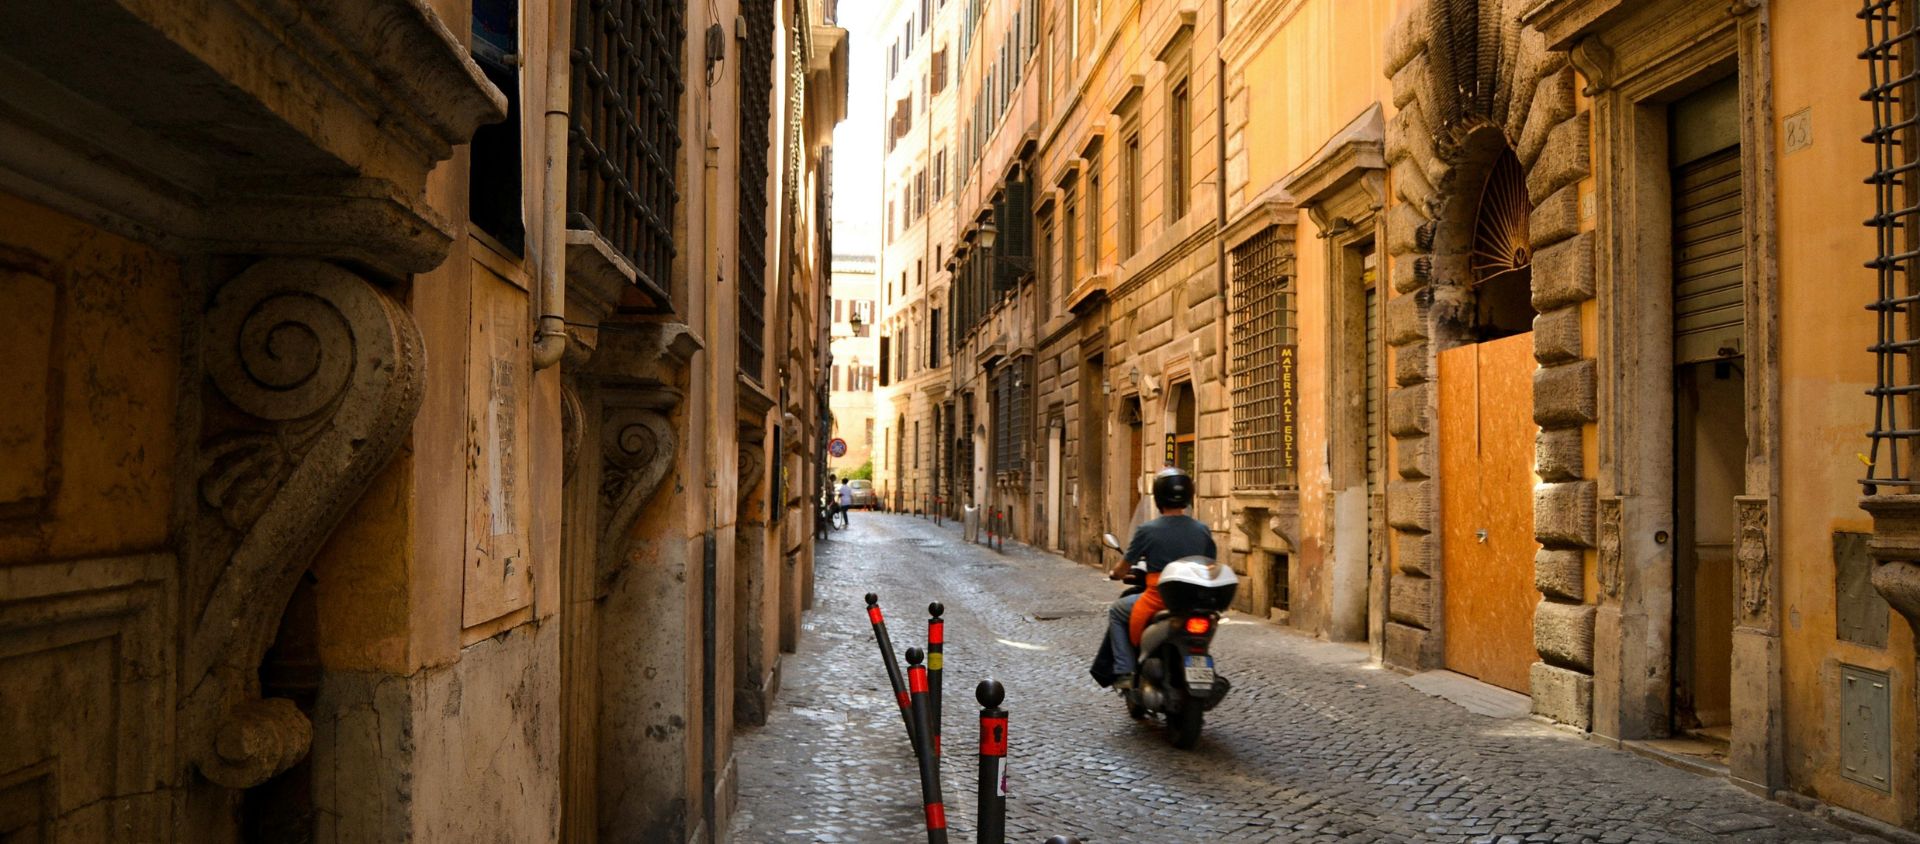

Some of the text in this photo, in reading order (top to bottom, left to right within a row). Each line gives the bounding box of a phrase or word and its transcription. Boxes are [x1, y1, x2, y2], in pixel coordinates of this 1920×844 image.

[1787, 118, 1806, 147] 85
[1281, 349, 1293, 467] MATERIALI EDILI
[1166, 436, 1175, 460] ARR
